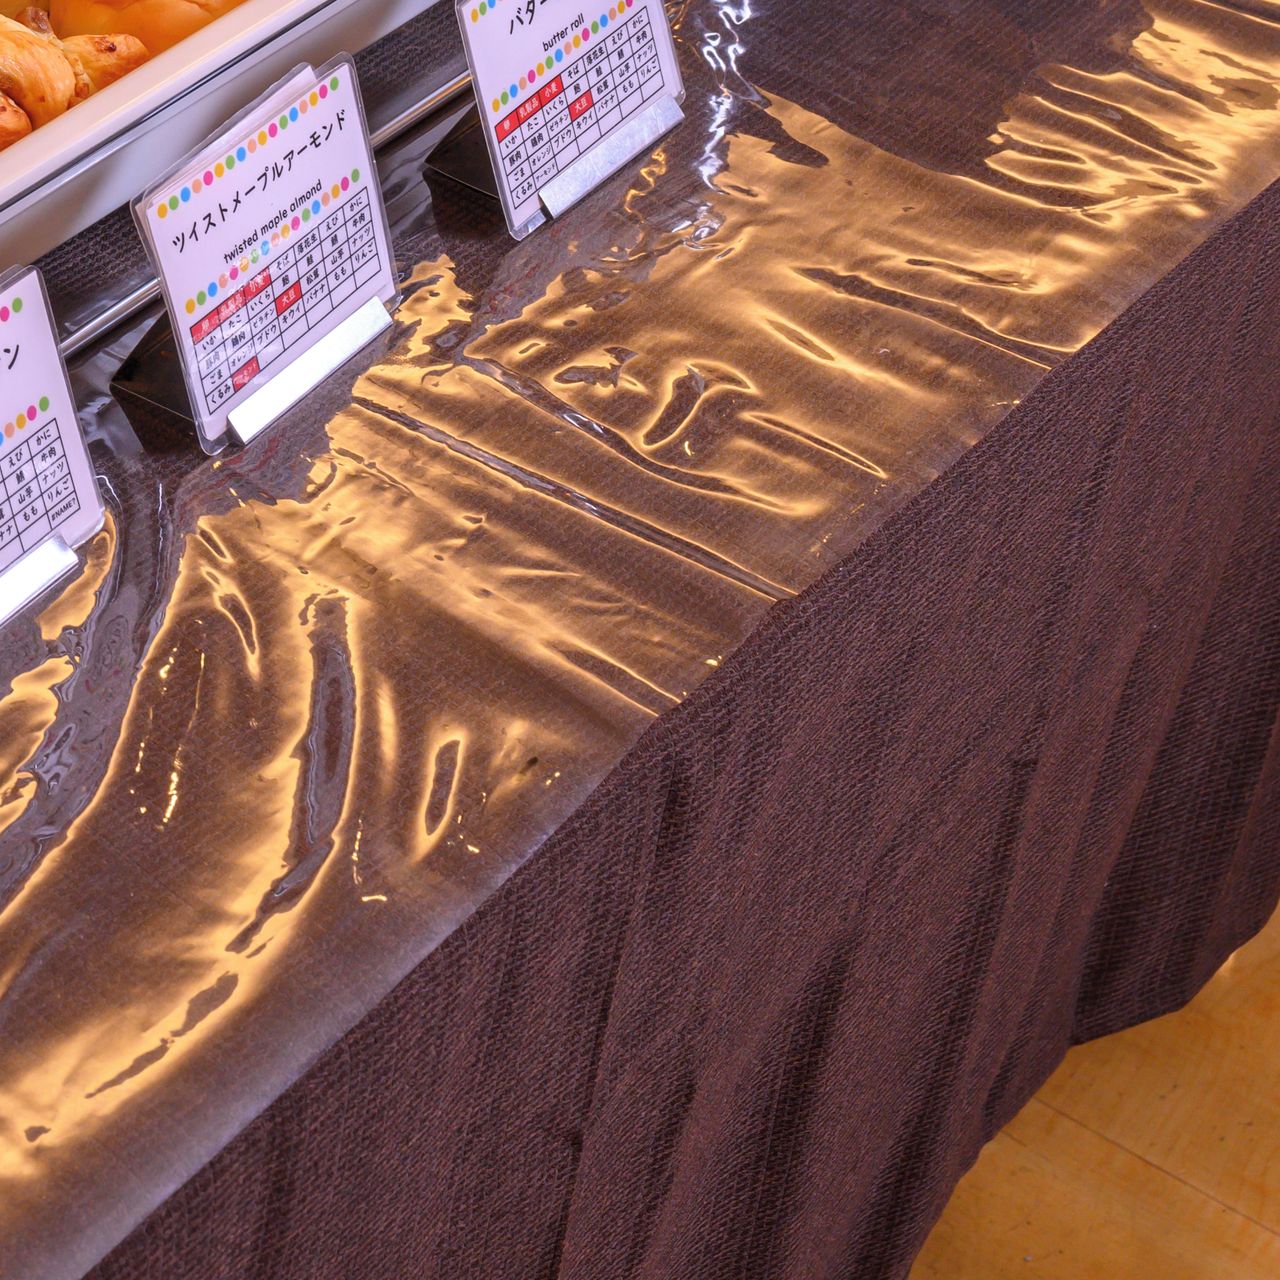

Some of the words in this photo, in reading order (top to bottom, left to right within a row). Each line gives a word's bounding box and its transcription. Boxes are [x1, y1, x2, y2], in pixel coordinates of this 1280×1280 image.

[543, 26, 568, 52] butter
[570, 13, 585, 31] roll
[505, 135, 517, 149] いか
[527, 117, 539, 131] たこ
[546, 97, 564, 115] いくら
[636, 30, 648, 44] 牛肉
[520, 98, 539, 118] 乳製品
[545, 81, 558, 97] 小麦
[568, 65, 580, 79] そば
[612, 30, 623, 46] えび
[632, 15, 643, 29] かに
[549, 113, 569, 132] ゼラチン
[574, 98, 587, 113] 大豆
[637, 44, 653, 61] ナッツ
[514, 167, 525, 181] ごま
[532, 145, 551, 166] オレンジ
[554, 129, 572, 148] ブドウ
[576, 111, 593, 130] キウイ
[598, 94, 615, 112] バナナ
[623, 80, 634, 93] もも
[641, 59, 657, 78] りんご
[172, 109, 346, 253] ツイストメープルアーモンド
[515, 181, 532, 200] くるみ
[536, 163, 555, 182] アーモンド
[223, 231, 259, 264] twisted
[260, 207, 288, 236] maple
[290, 179, 323, 213] almond
[326, 214, 339, 232] えび
[350, 197, 362, 212] かに
[202, 336, 216, 350] いか
[228, 314, 242, 328] たこ
[251, 291, 270, 311] いくら
[352, 212, 365, 228] 牛肉
[282, 288, 296, 304] 大豆
[352, 226, 370, 247] ナッツ
[210, 369, 222, 384] ごま
[257, 324, 276, 344] ブドウ
[282, 302, 300, 324] キウイ
[306, 283, 325, 303] バナナ
[334, 266, 346, 281] もも
[355, 242, 373, 263] りんご
[211, 384, 231, 404] くるみ
[9, 449, 24, 468] えび
[36, 429, 51, 445] かに
[41, 446, 57, 462] 牛肉
[42, 461, 64, 485] ナッツ
[23, 506, 38, 521] もも
[48, 478, 70, 501] りんご
[52, 498, 76, 521] #NAME?
